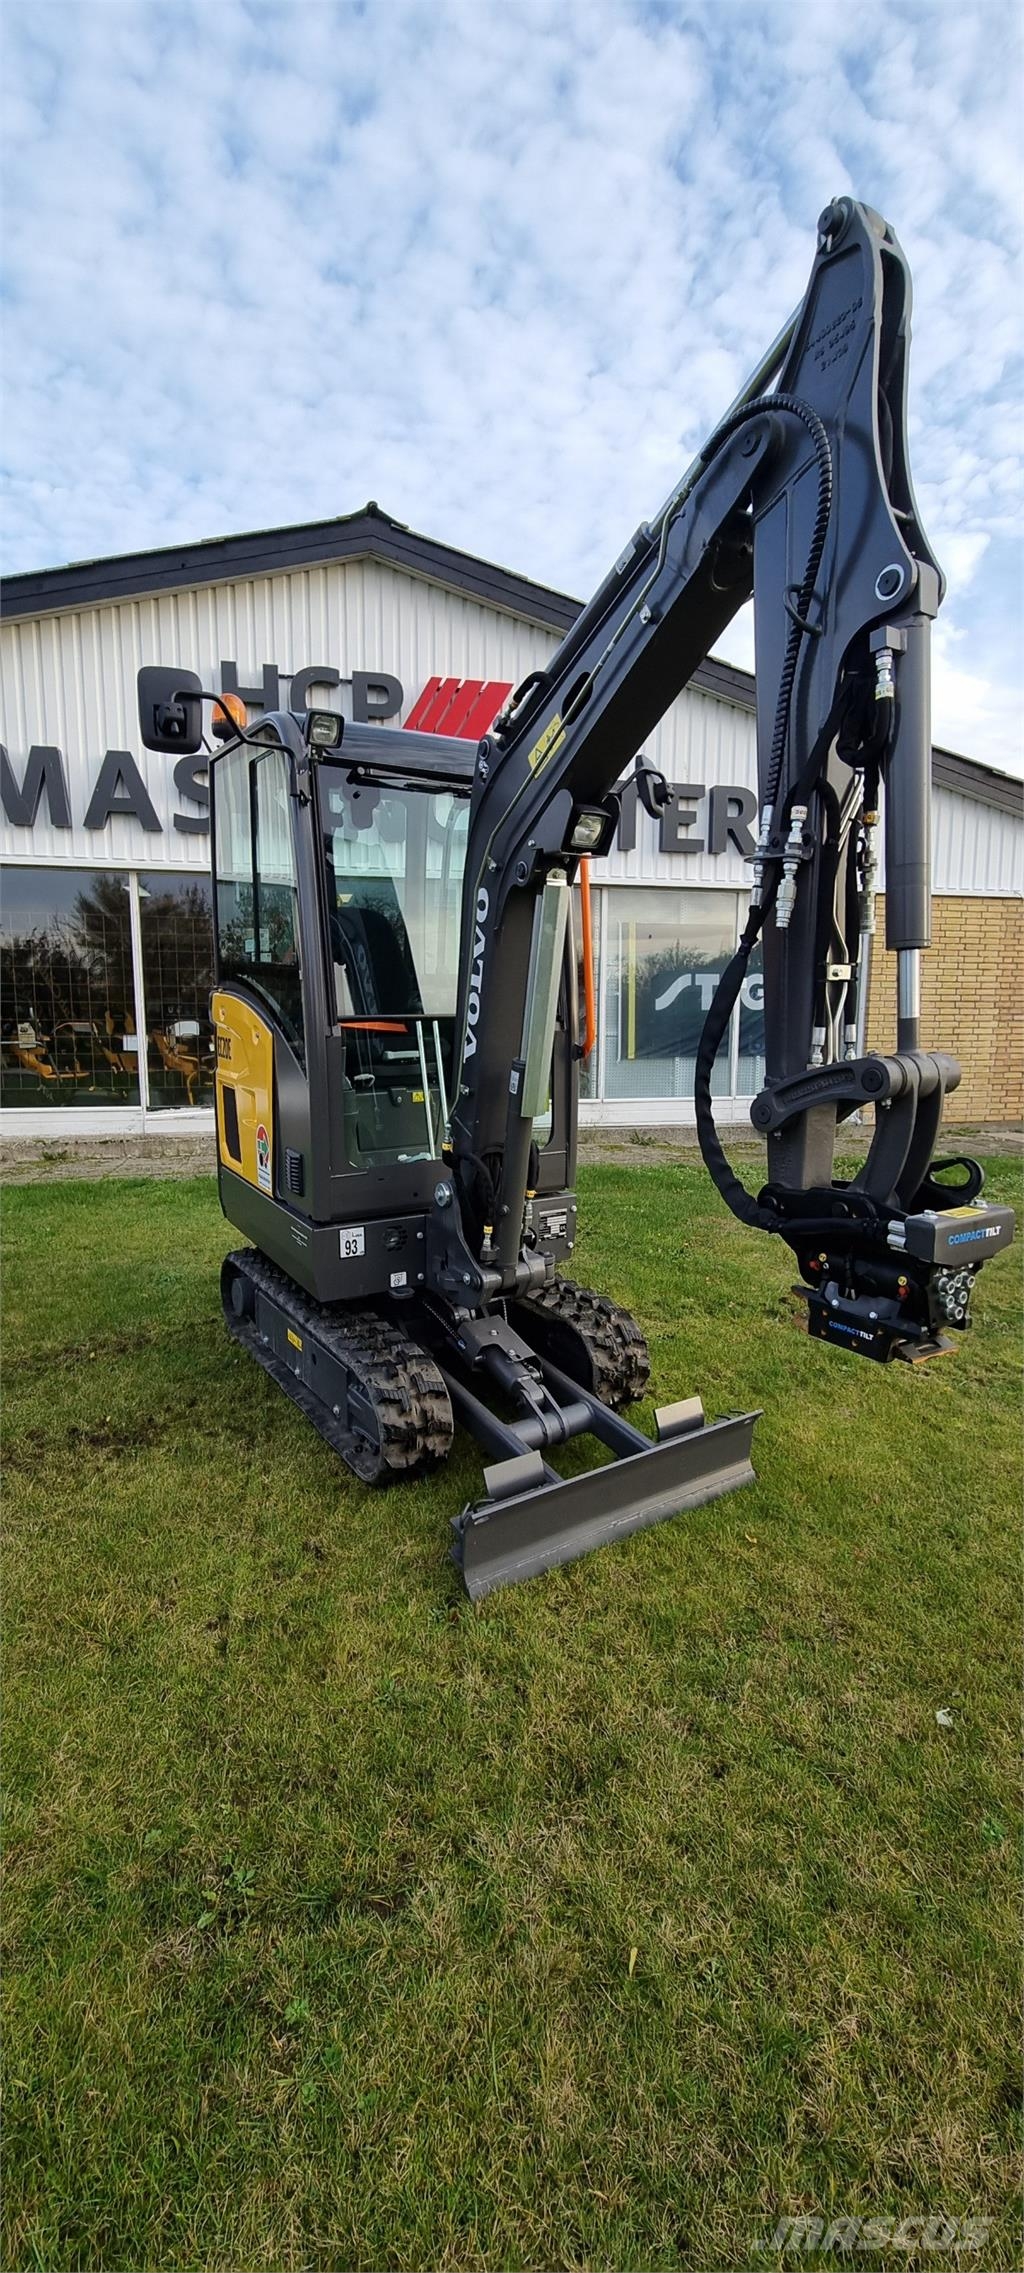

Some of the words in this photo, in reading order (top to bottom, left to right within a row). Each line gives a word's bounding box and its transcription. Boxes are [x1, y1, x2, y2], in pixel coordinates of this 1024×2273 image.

[220, 660, 404, 724] HCP
[0, 743, 210, 834] MAS
[615, 780, 759, 855] TER
[462, 887, 489, 1064] VOLVO
[655, 973, 765, 1011] STG
[345, 1238, 358, 1256] 93
[947, 1225, 1002, 1246] COMPACTTILT
[829, 1320, 875, 1341] COMPACTTILT
